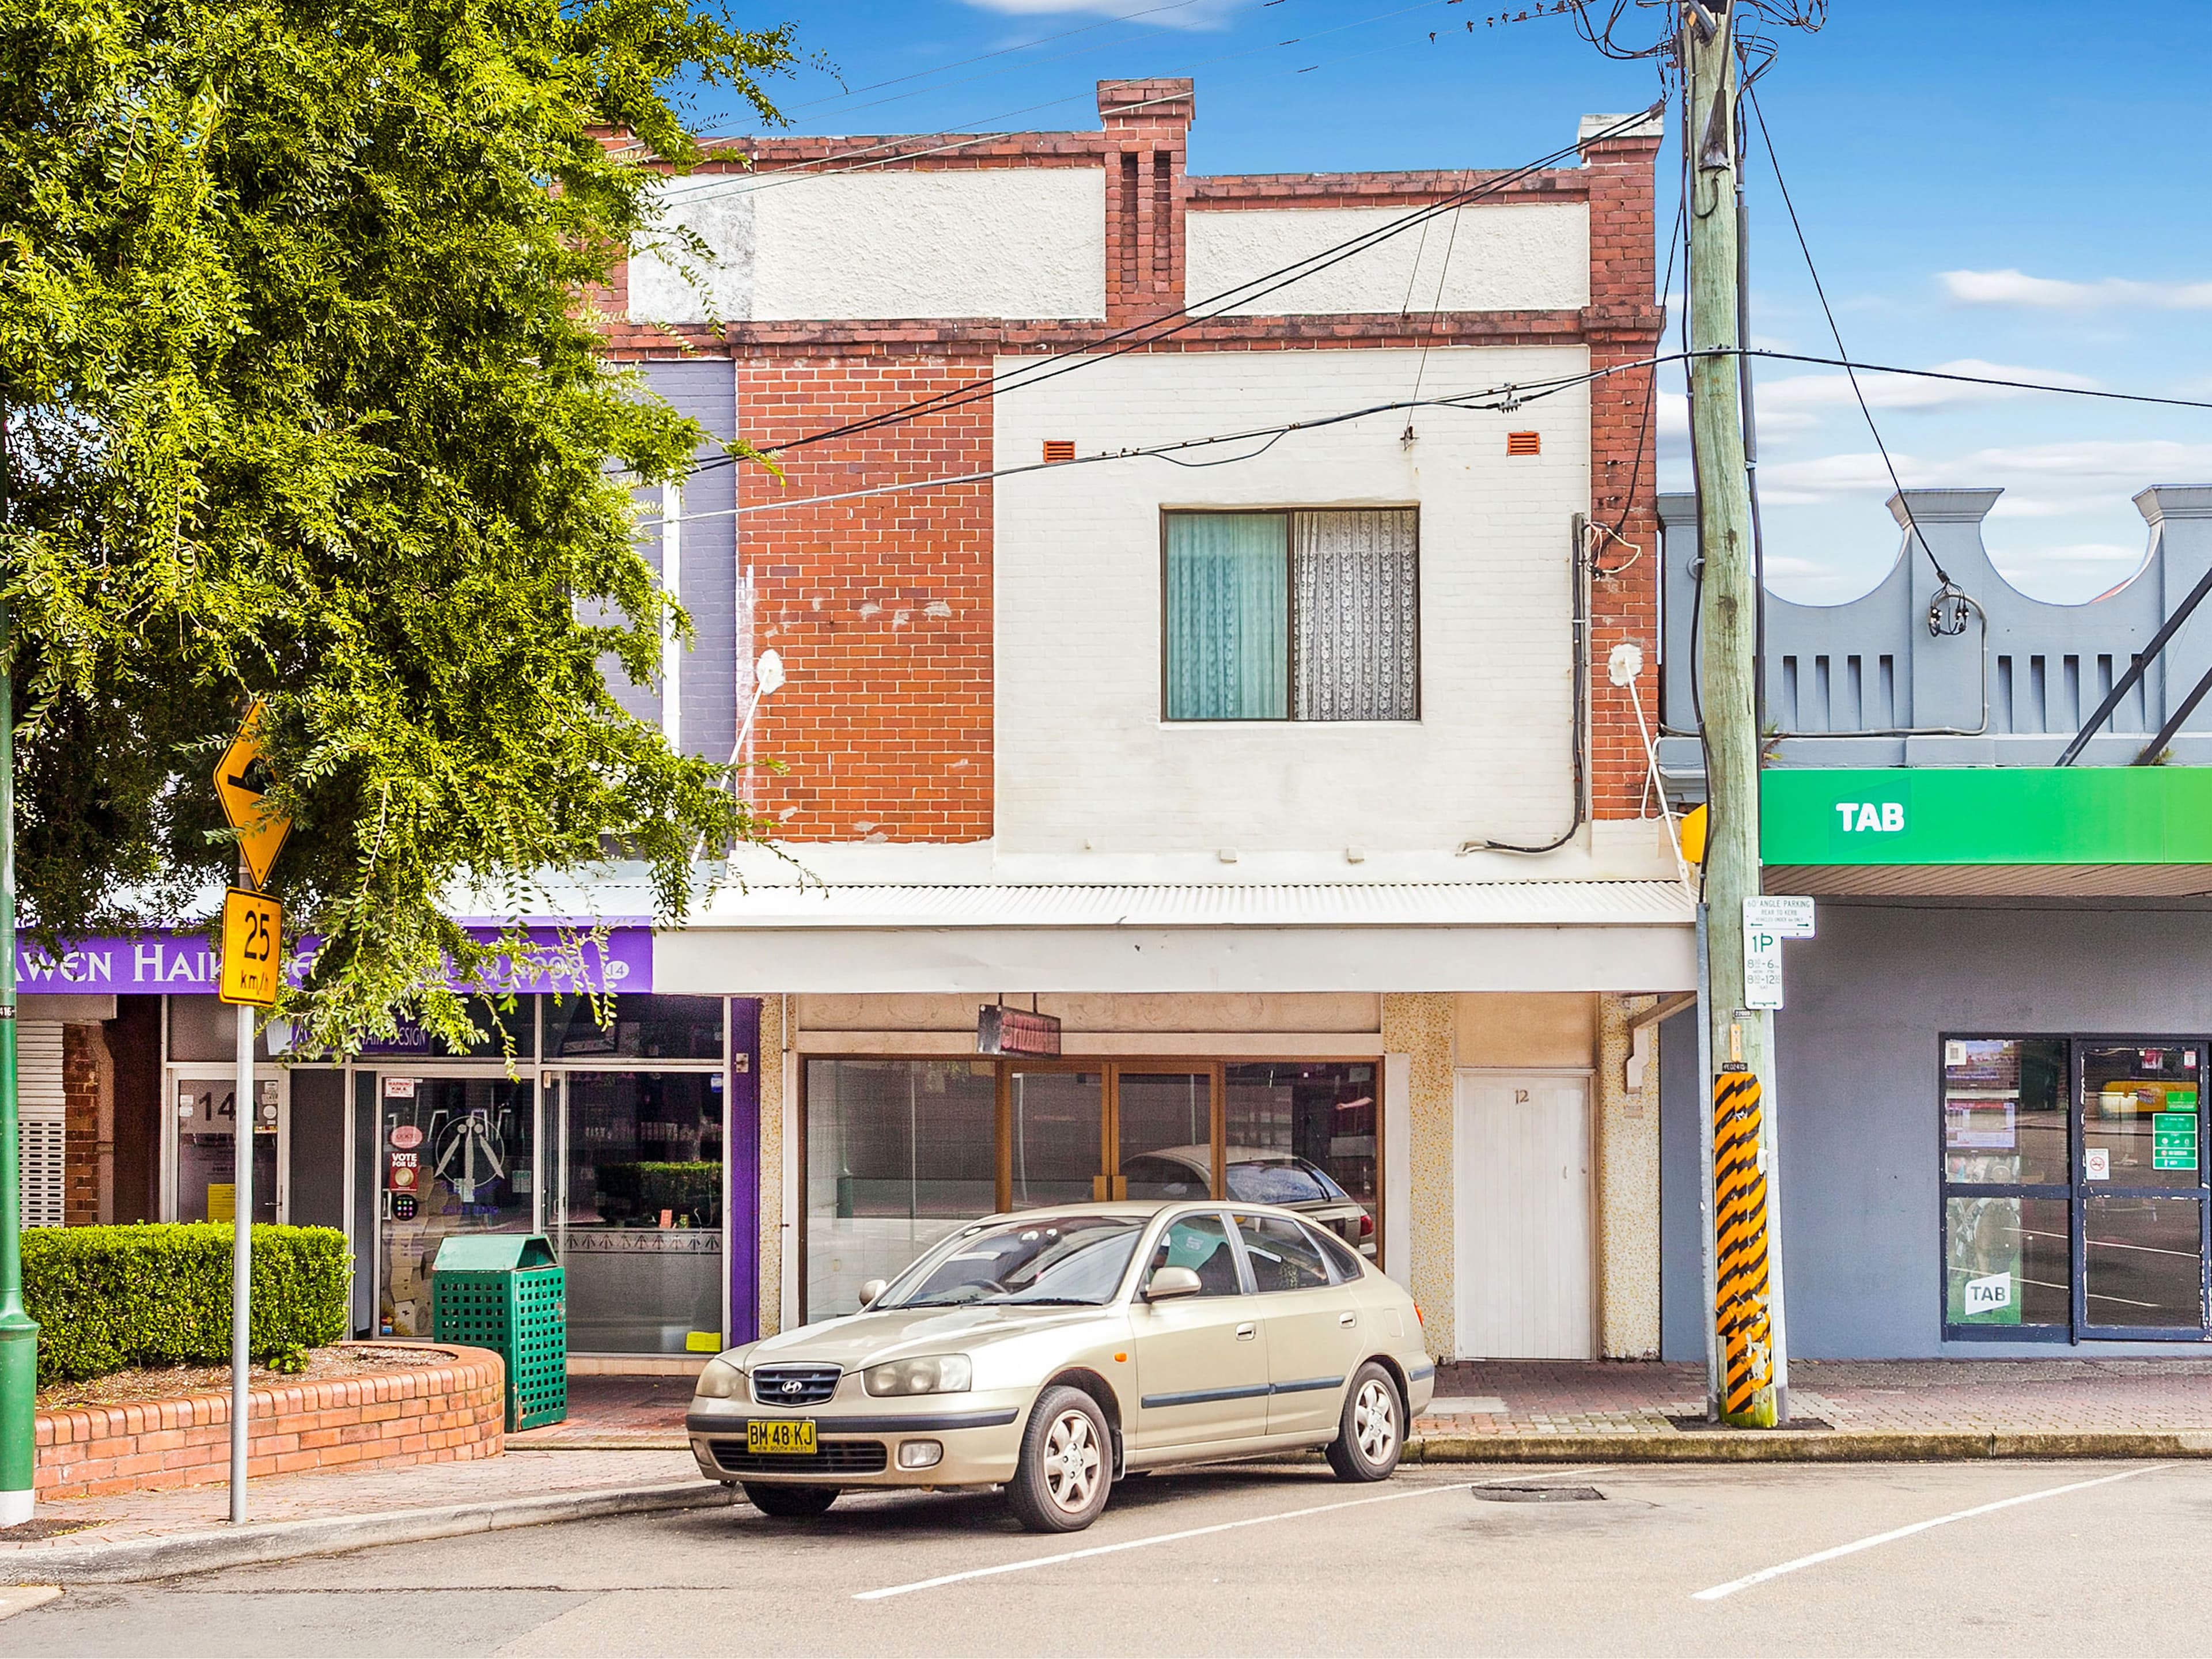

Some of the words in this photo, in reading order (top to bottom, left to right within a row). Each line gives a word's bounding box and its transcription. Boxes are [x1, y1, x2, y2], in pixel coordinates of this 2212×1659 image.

[1836, 803, 1904, 832] TAB
[1783, 900, 1810, 908] PARKING
[244, 910, 270, 961] 25
[1752, 935, 1773, 952] 1P
[608, 964, 624, 976] 14
[1515, 1089, 1529, 1104] 12
[392, 1153, 418, 1161] VOTE
[1971, 1286, 2005, 1301] TAB
